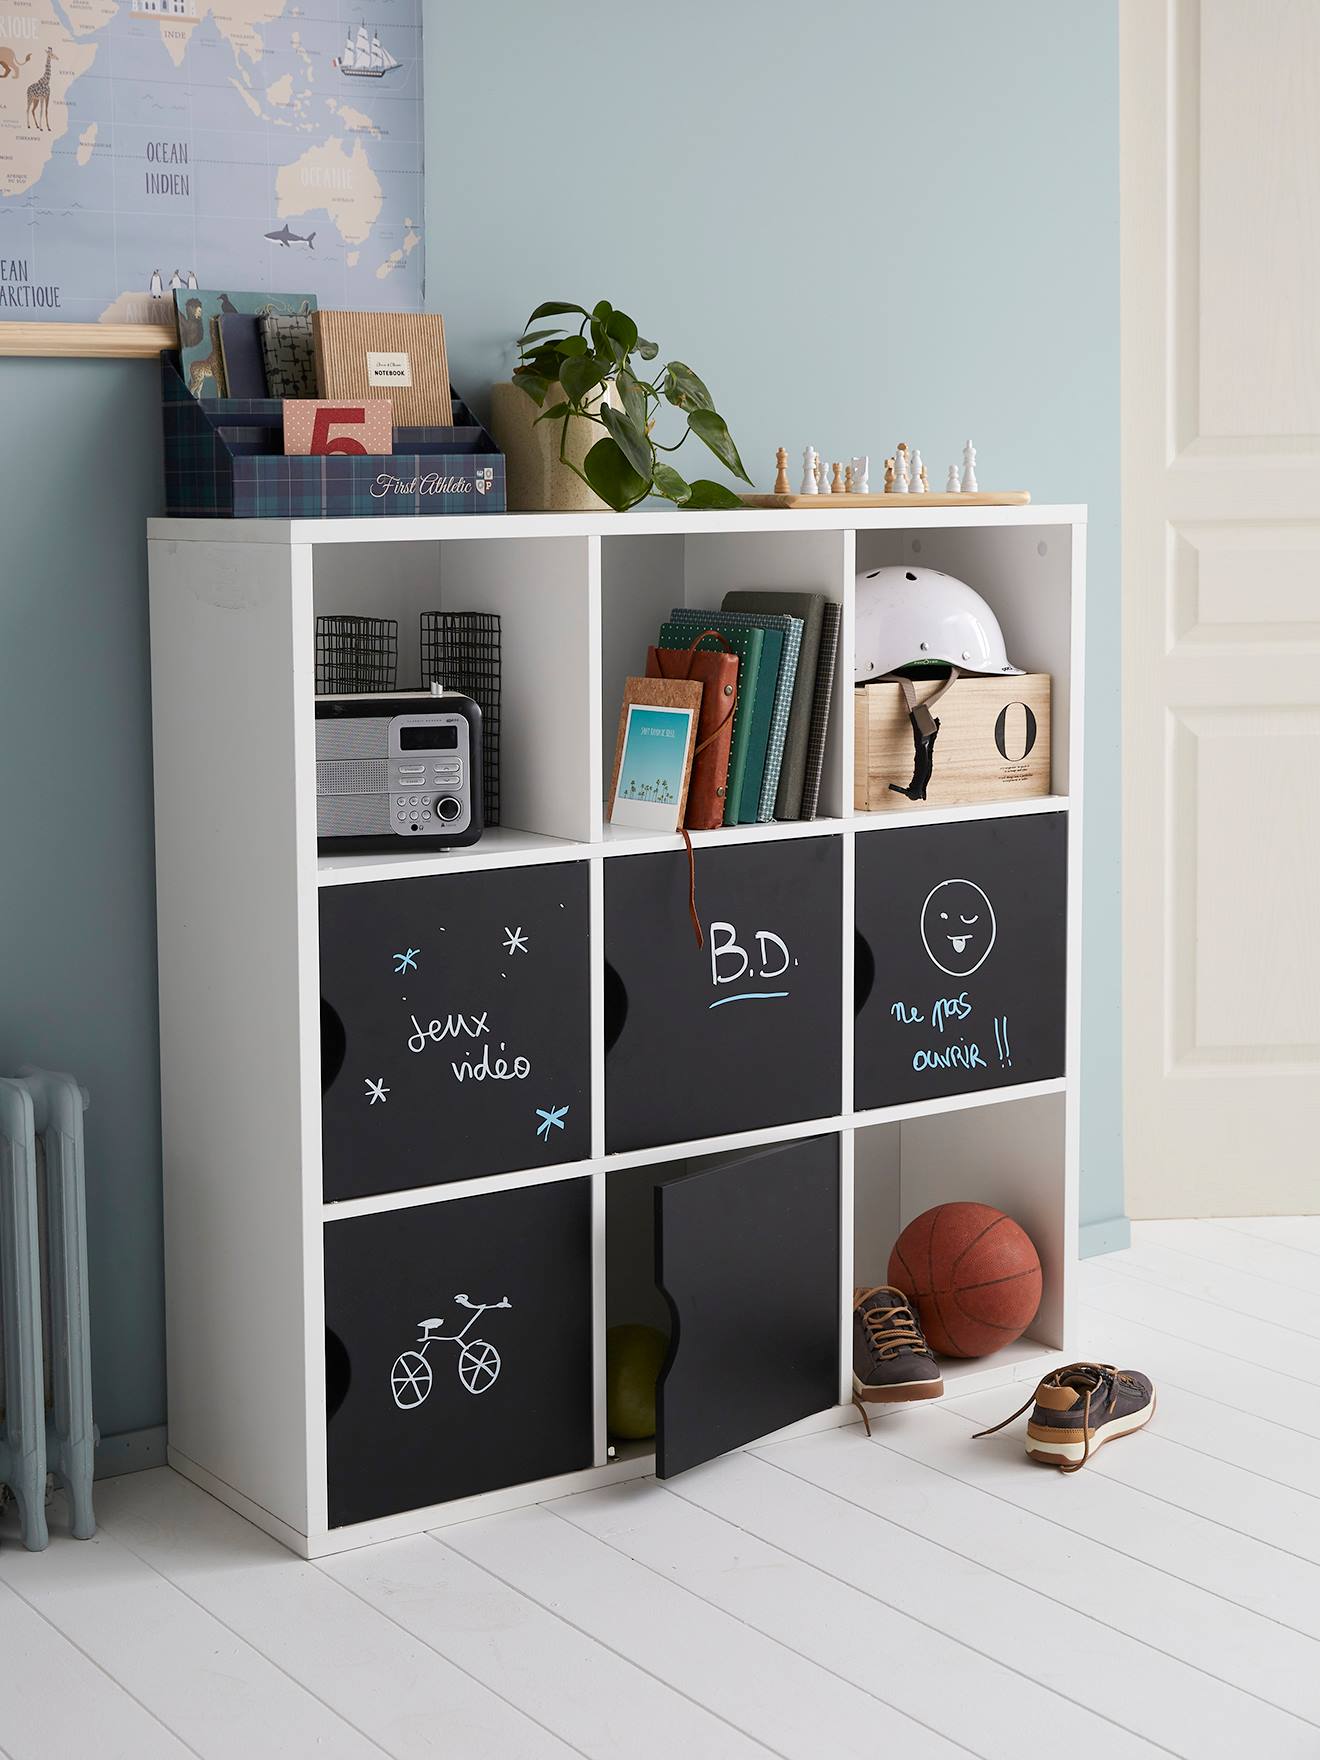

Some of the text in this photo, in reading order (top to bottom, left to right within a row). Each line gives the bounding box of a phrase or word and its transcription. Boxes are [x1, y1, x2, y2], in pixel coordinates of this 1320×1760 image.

[164, 30, 186, 40] INDE
[146, 141, 188, 164] OCEAN
[145, 172, 189, 196] INDIEN
[0, 259, 28, 282] EAN
[0, 285, 61, 309] ARCTIQUE
[310, 408, 368, 455] 5
[369, 472, 472, 498] First Athletic
[995, 701, 1037, 762] O
[710, 921, 799, 985] B.D.
[891, 992, 972, 1032] ne pas
[408, 1012, 490, 1052] jeux
[452, 1042, 531, 1082] vidéo
